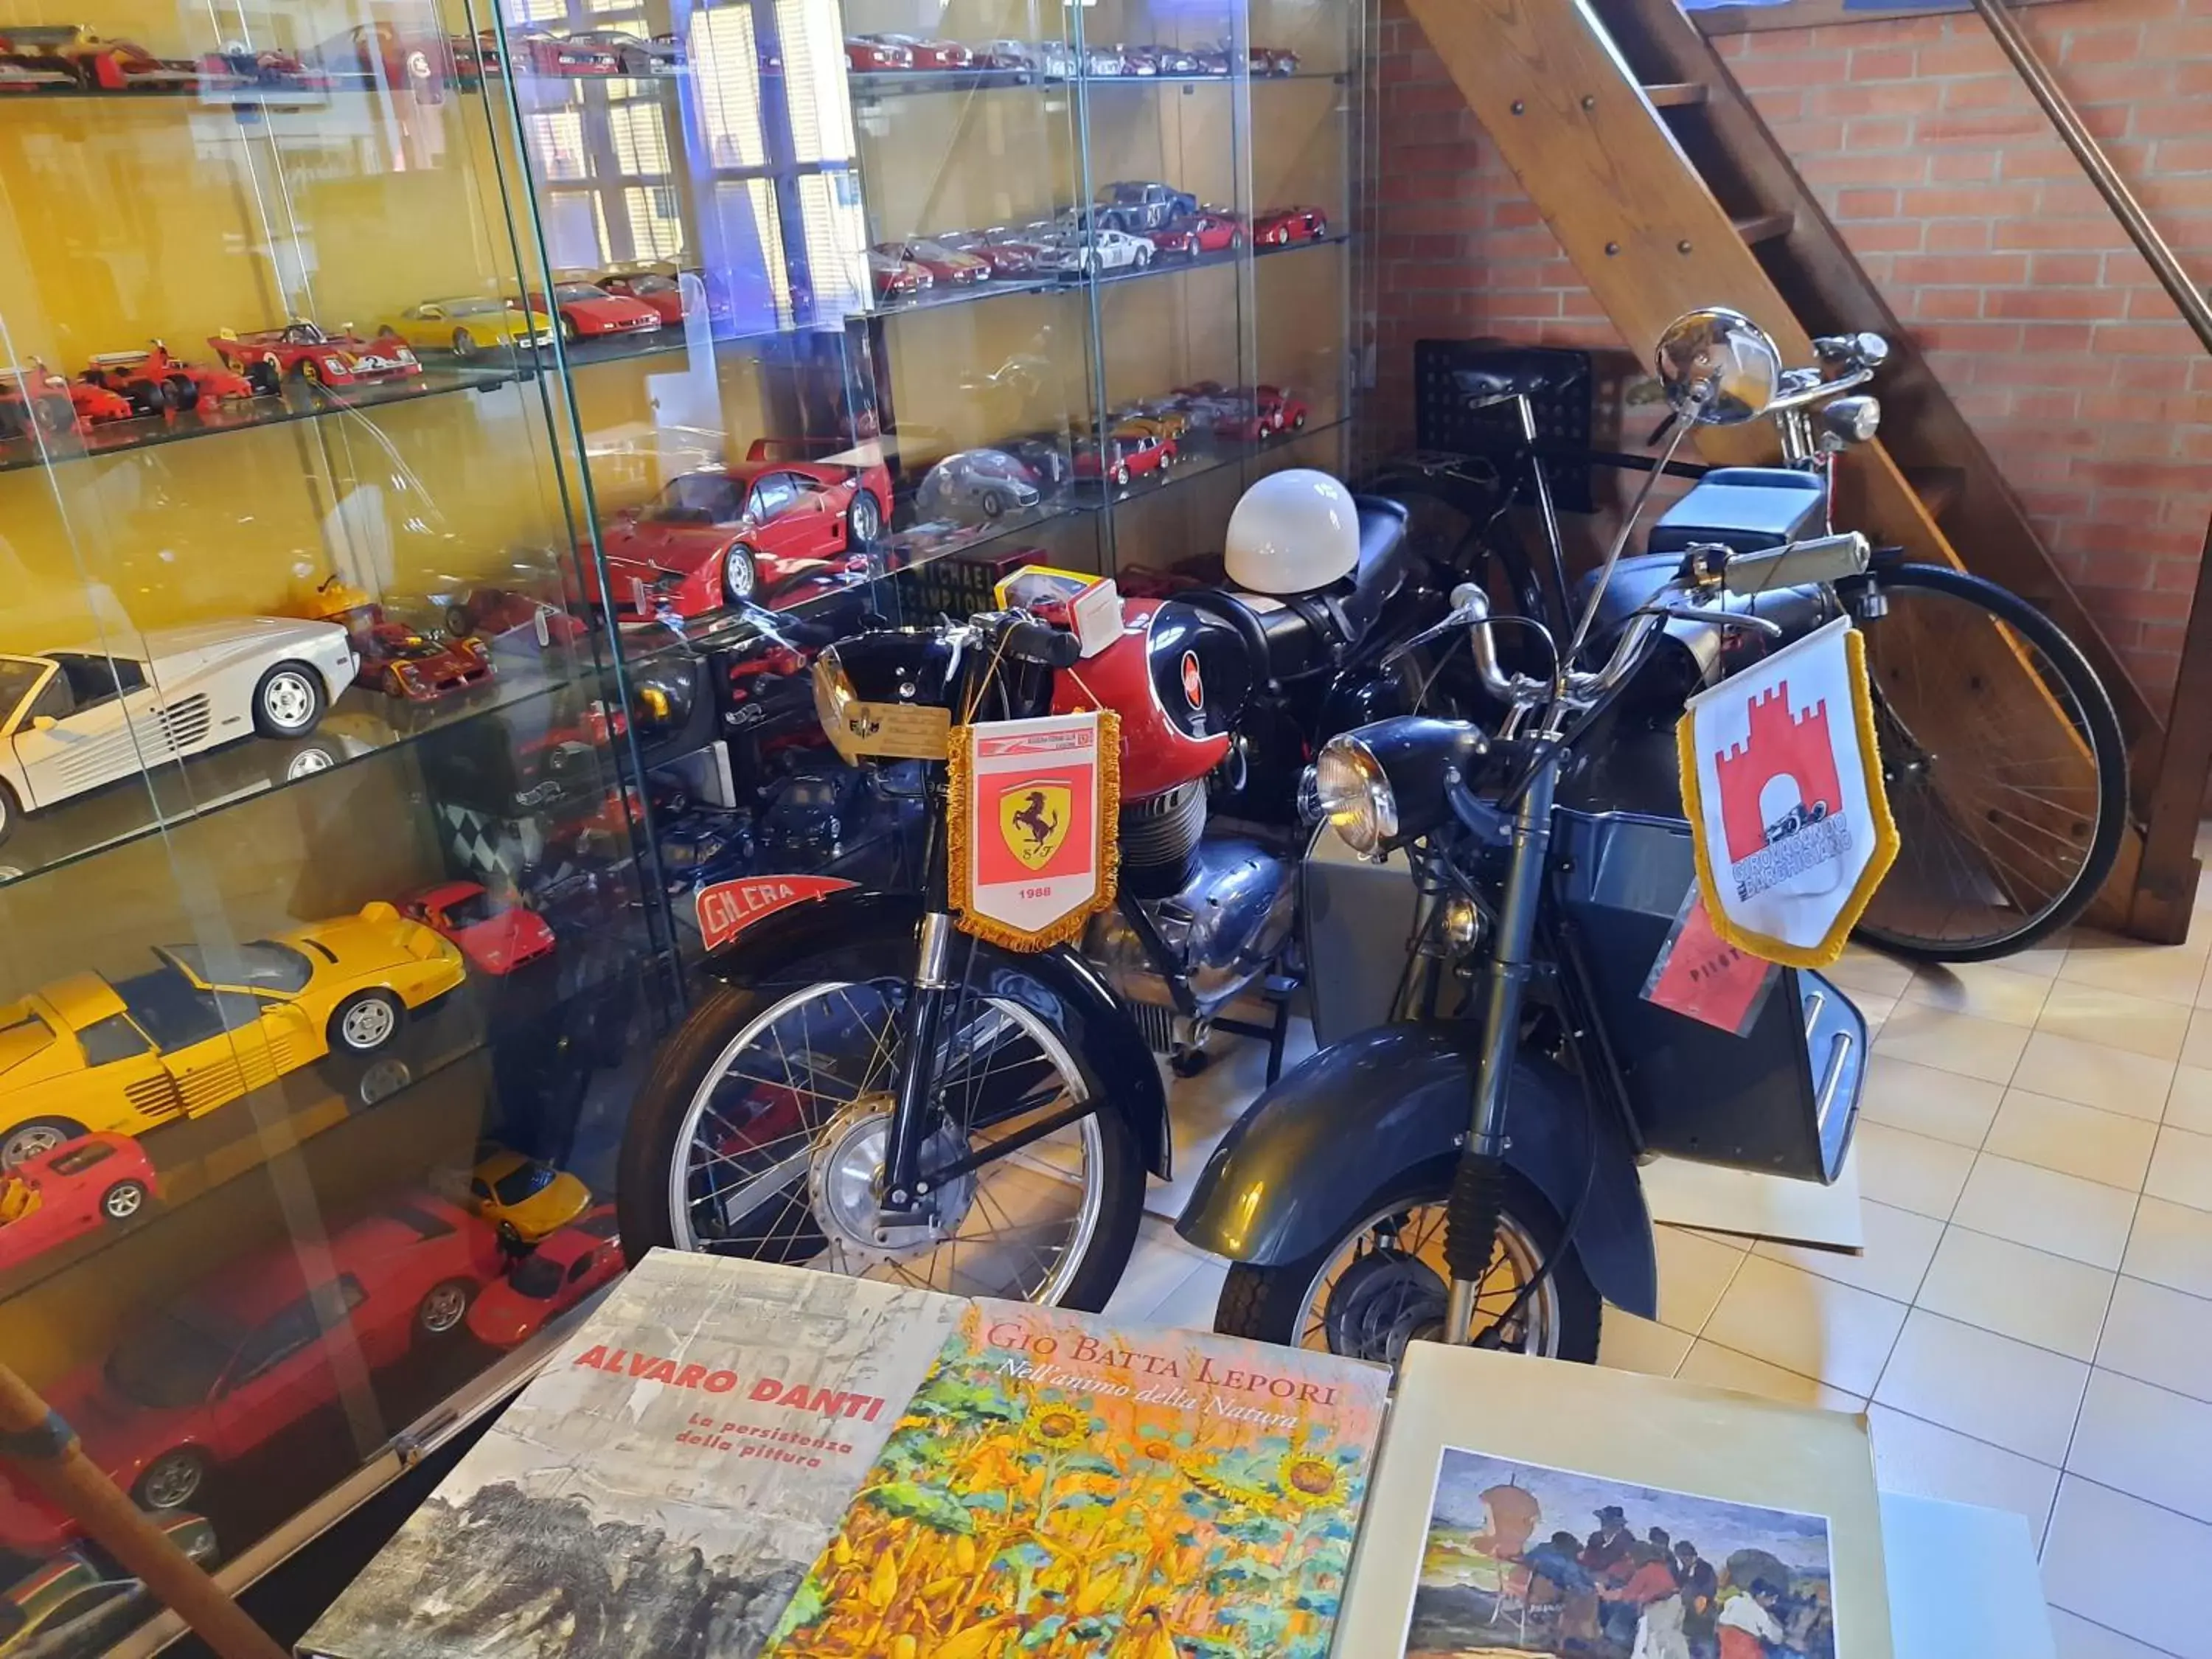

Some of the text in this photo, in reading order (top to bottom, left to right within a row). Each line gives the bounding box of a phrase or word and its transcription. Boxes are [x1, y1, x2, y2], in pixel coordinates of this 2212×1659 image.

[703, 883, 796, 934] GILERA
[1018, 886, 1051, 899] 1988
[574, 1344, 886, 1422] ALVARO DANTI
[987, 1322, 1337, 1406] GIO BATTA LEPORI
[995, 1357, 1299, 1429] Nell'animo della Natura
[674, 1429, 822, 1469] della pittura
[689, 1411, 854, 1455] La persistenza
